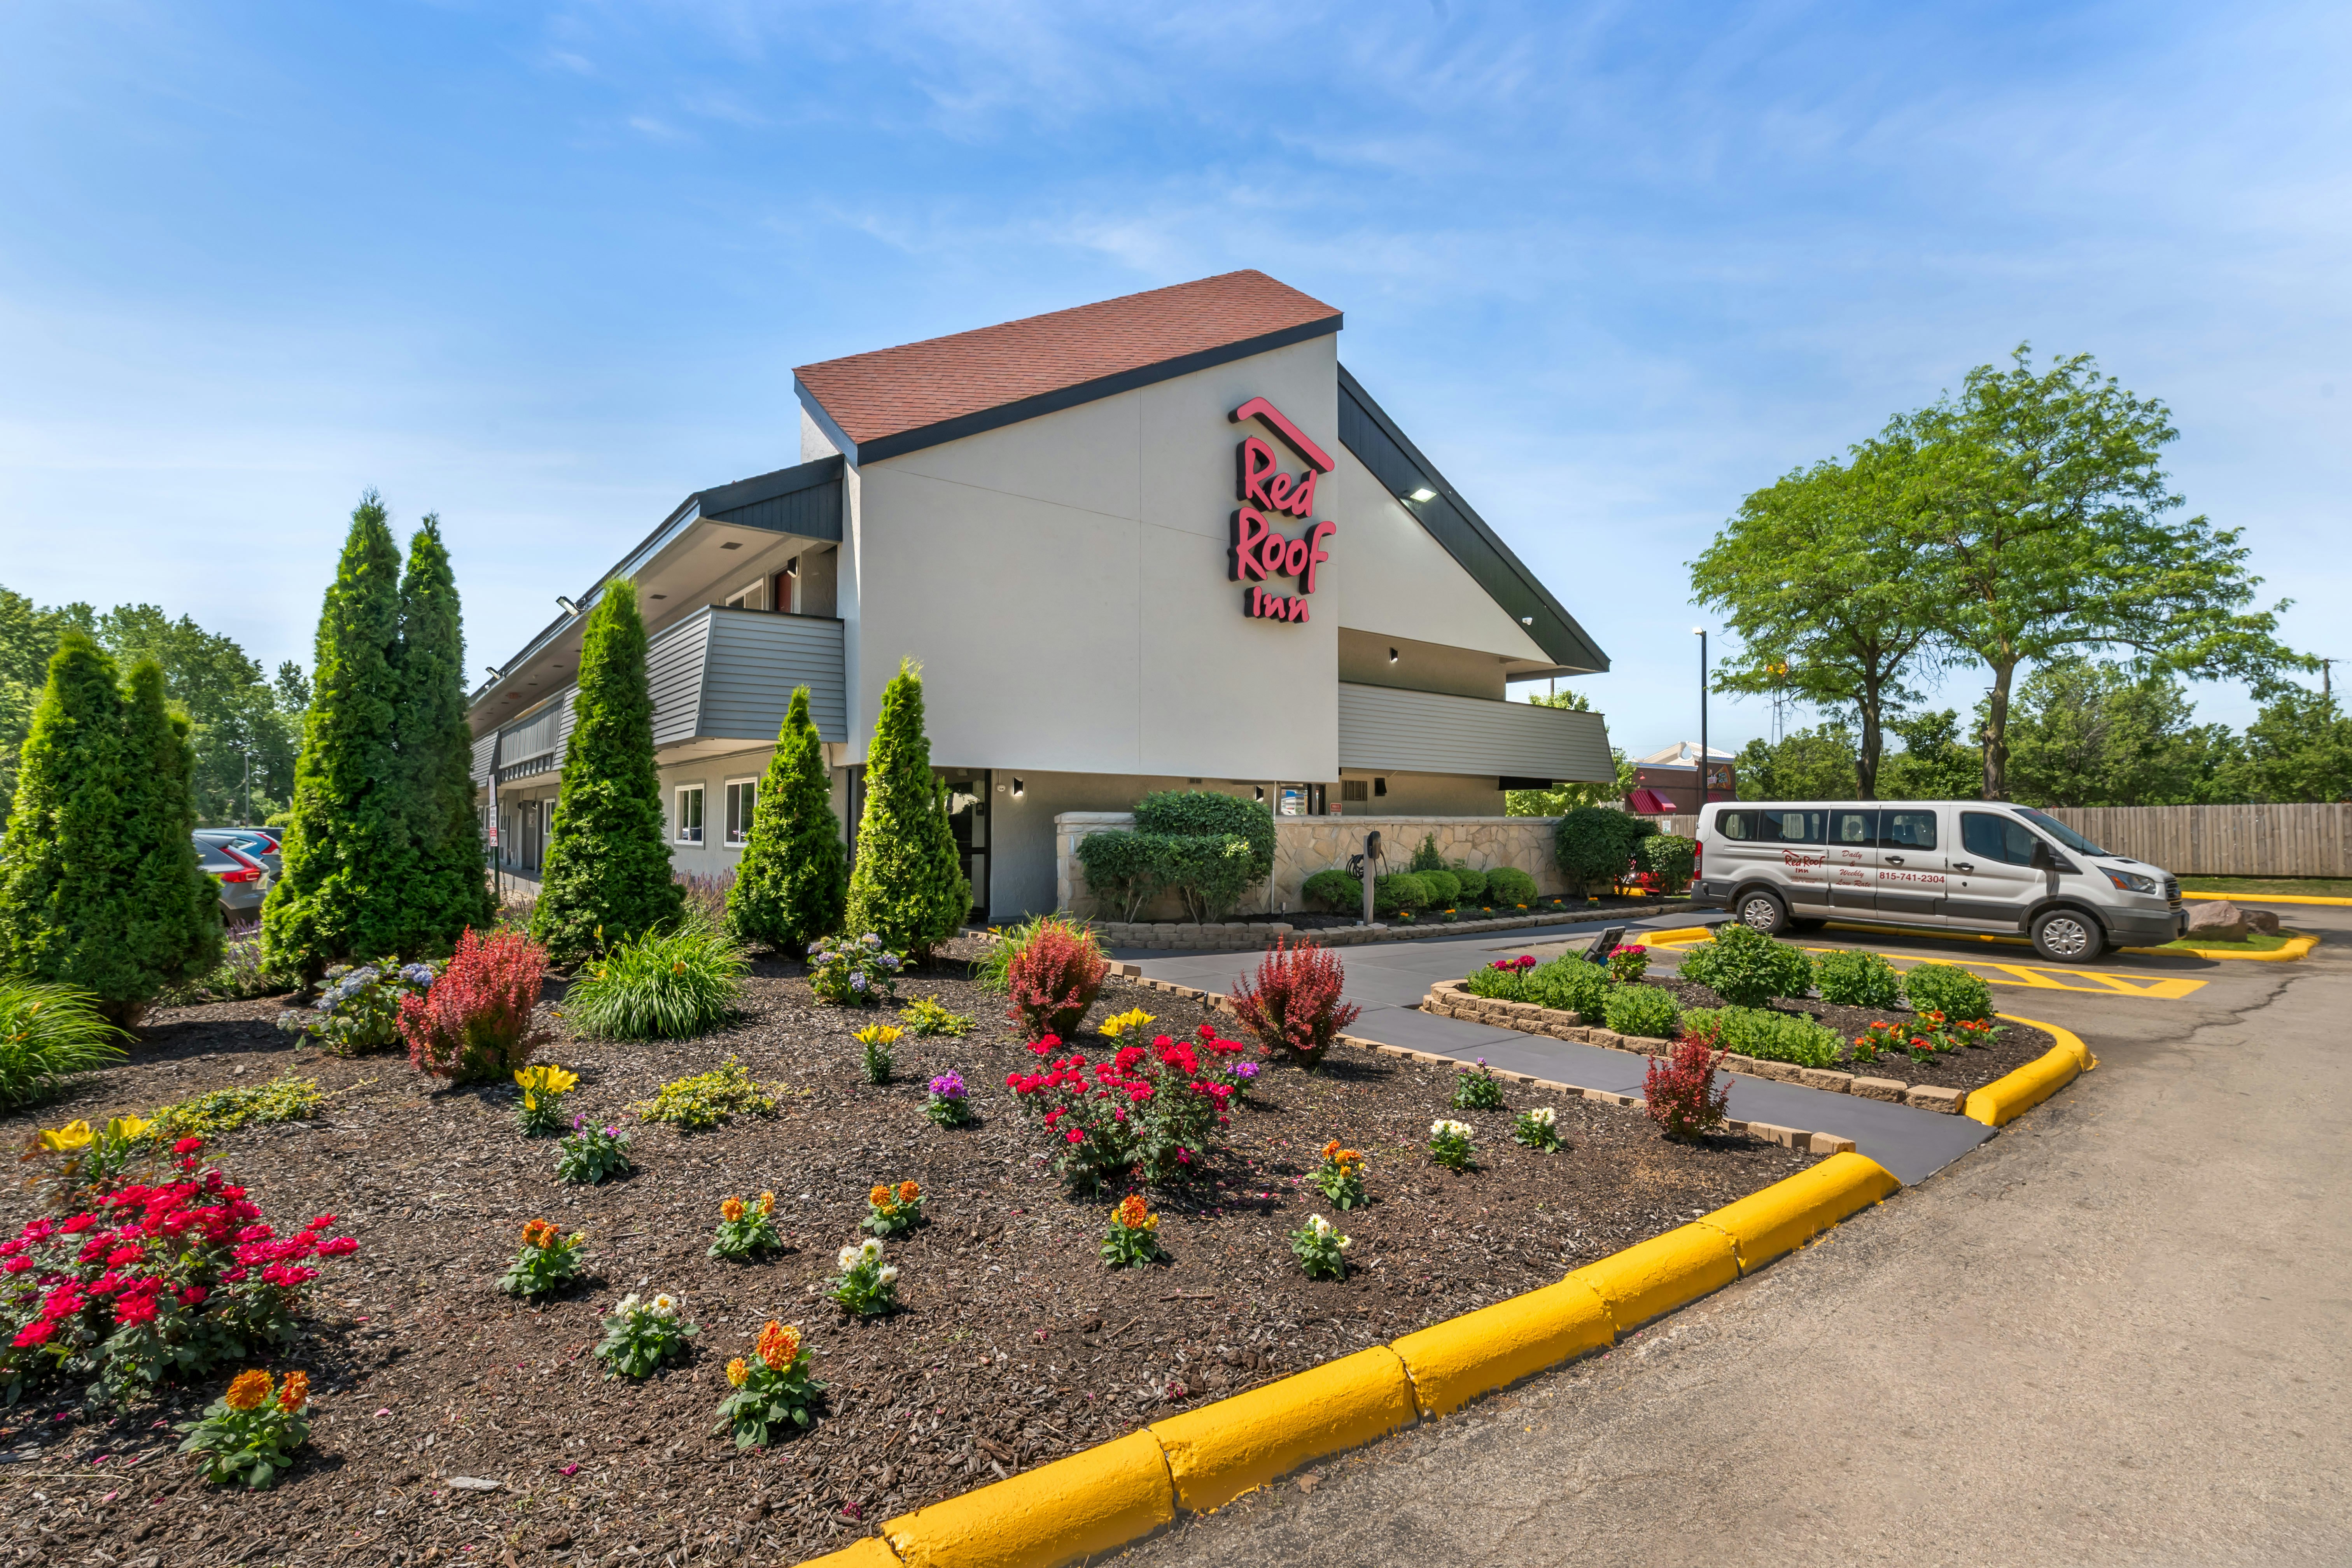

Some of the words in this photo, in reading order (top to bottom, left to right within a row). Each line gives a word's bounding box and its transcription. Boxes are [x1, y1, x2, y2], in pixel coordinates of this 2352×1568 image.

[1241, 437, 1317, 518] Red
[1234, 506, 1337, 594] Roof
[1249, 586, 1310, 623] Inn
[1842, 850, 1863, 859] Daily
[1785, 855, 1801, 866] Red
[1803, 856, 1826, 868] Roof
[1839, 869, 1864, 878] Weekly
[1879, 872, 1945, 884] 815-741-2304
